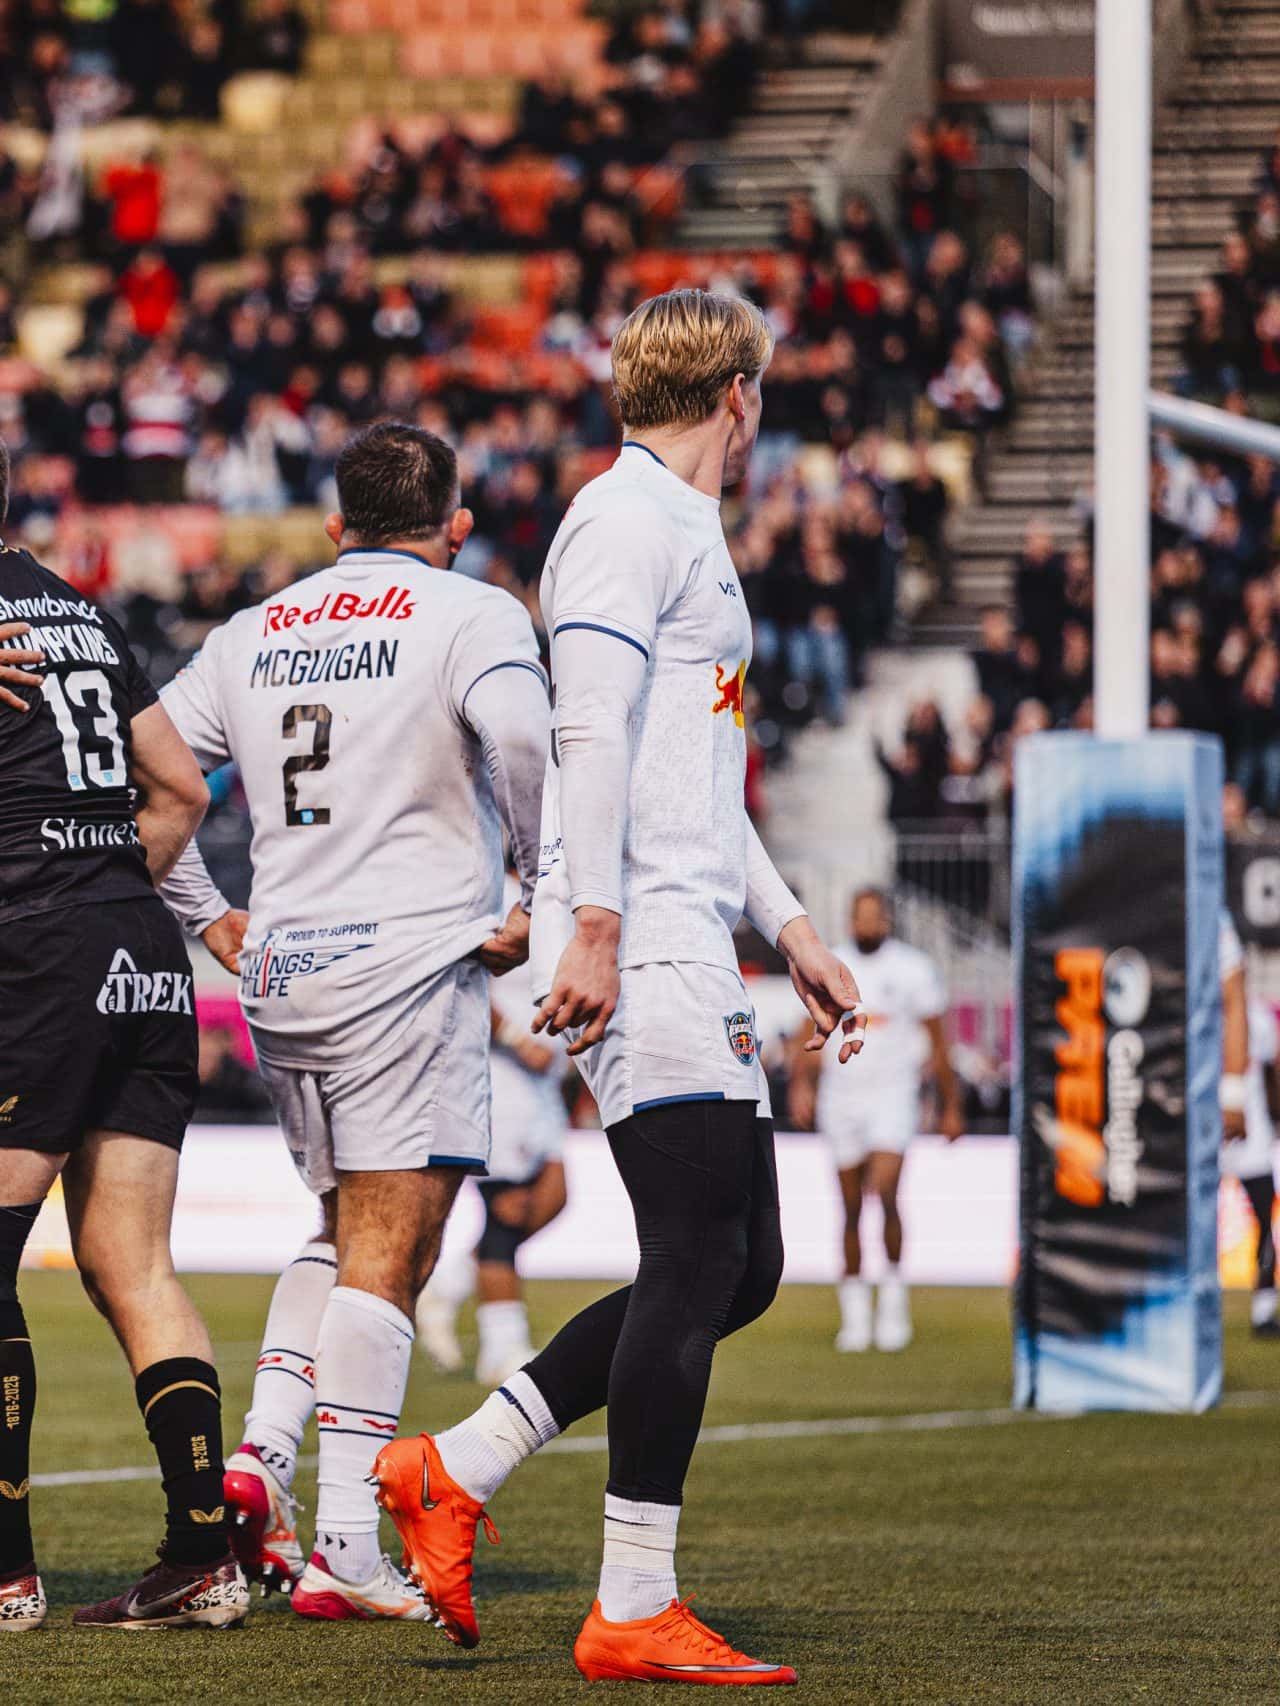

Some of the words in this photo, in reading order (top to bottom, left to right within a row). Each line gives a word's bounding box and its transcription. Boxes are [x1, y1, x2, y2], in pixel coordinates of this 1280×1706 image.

[263, 593, 331, 638] Red
[328, 586, 419, 621] Bulls
[250, 640, 399, 688] MCGUIGAN
[43, 670, 128, 792] 13
[282, 704, 333, 826] 2
[329, 923, 379, 937] SUPPORT
[242, 948, 314, 976] WINGS
[106, 971, 192, 1016] TREK
